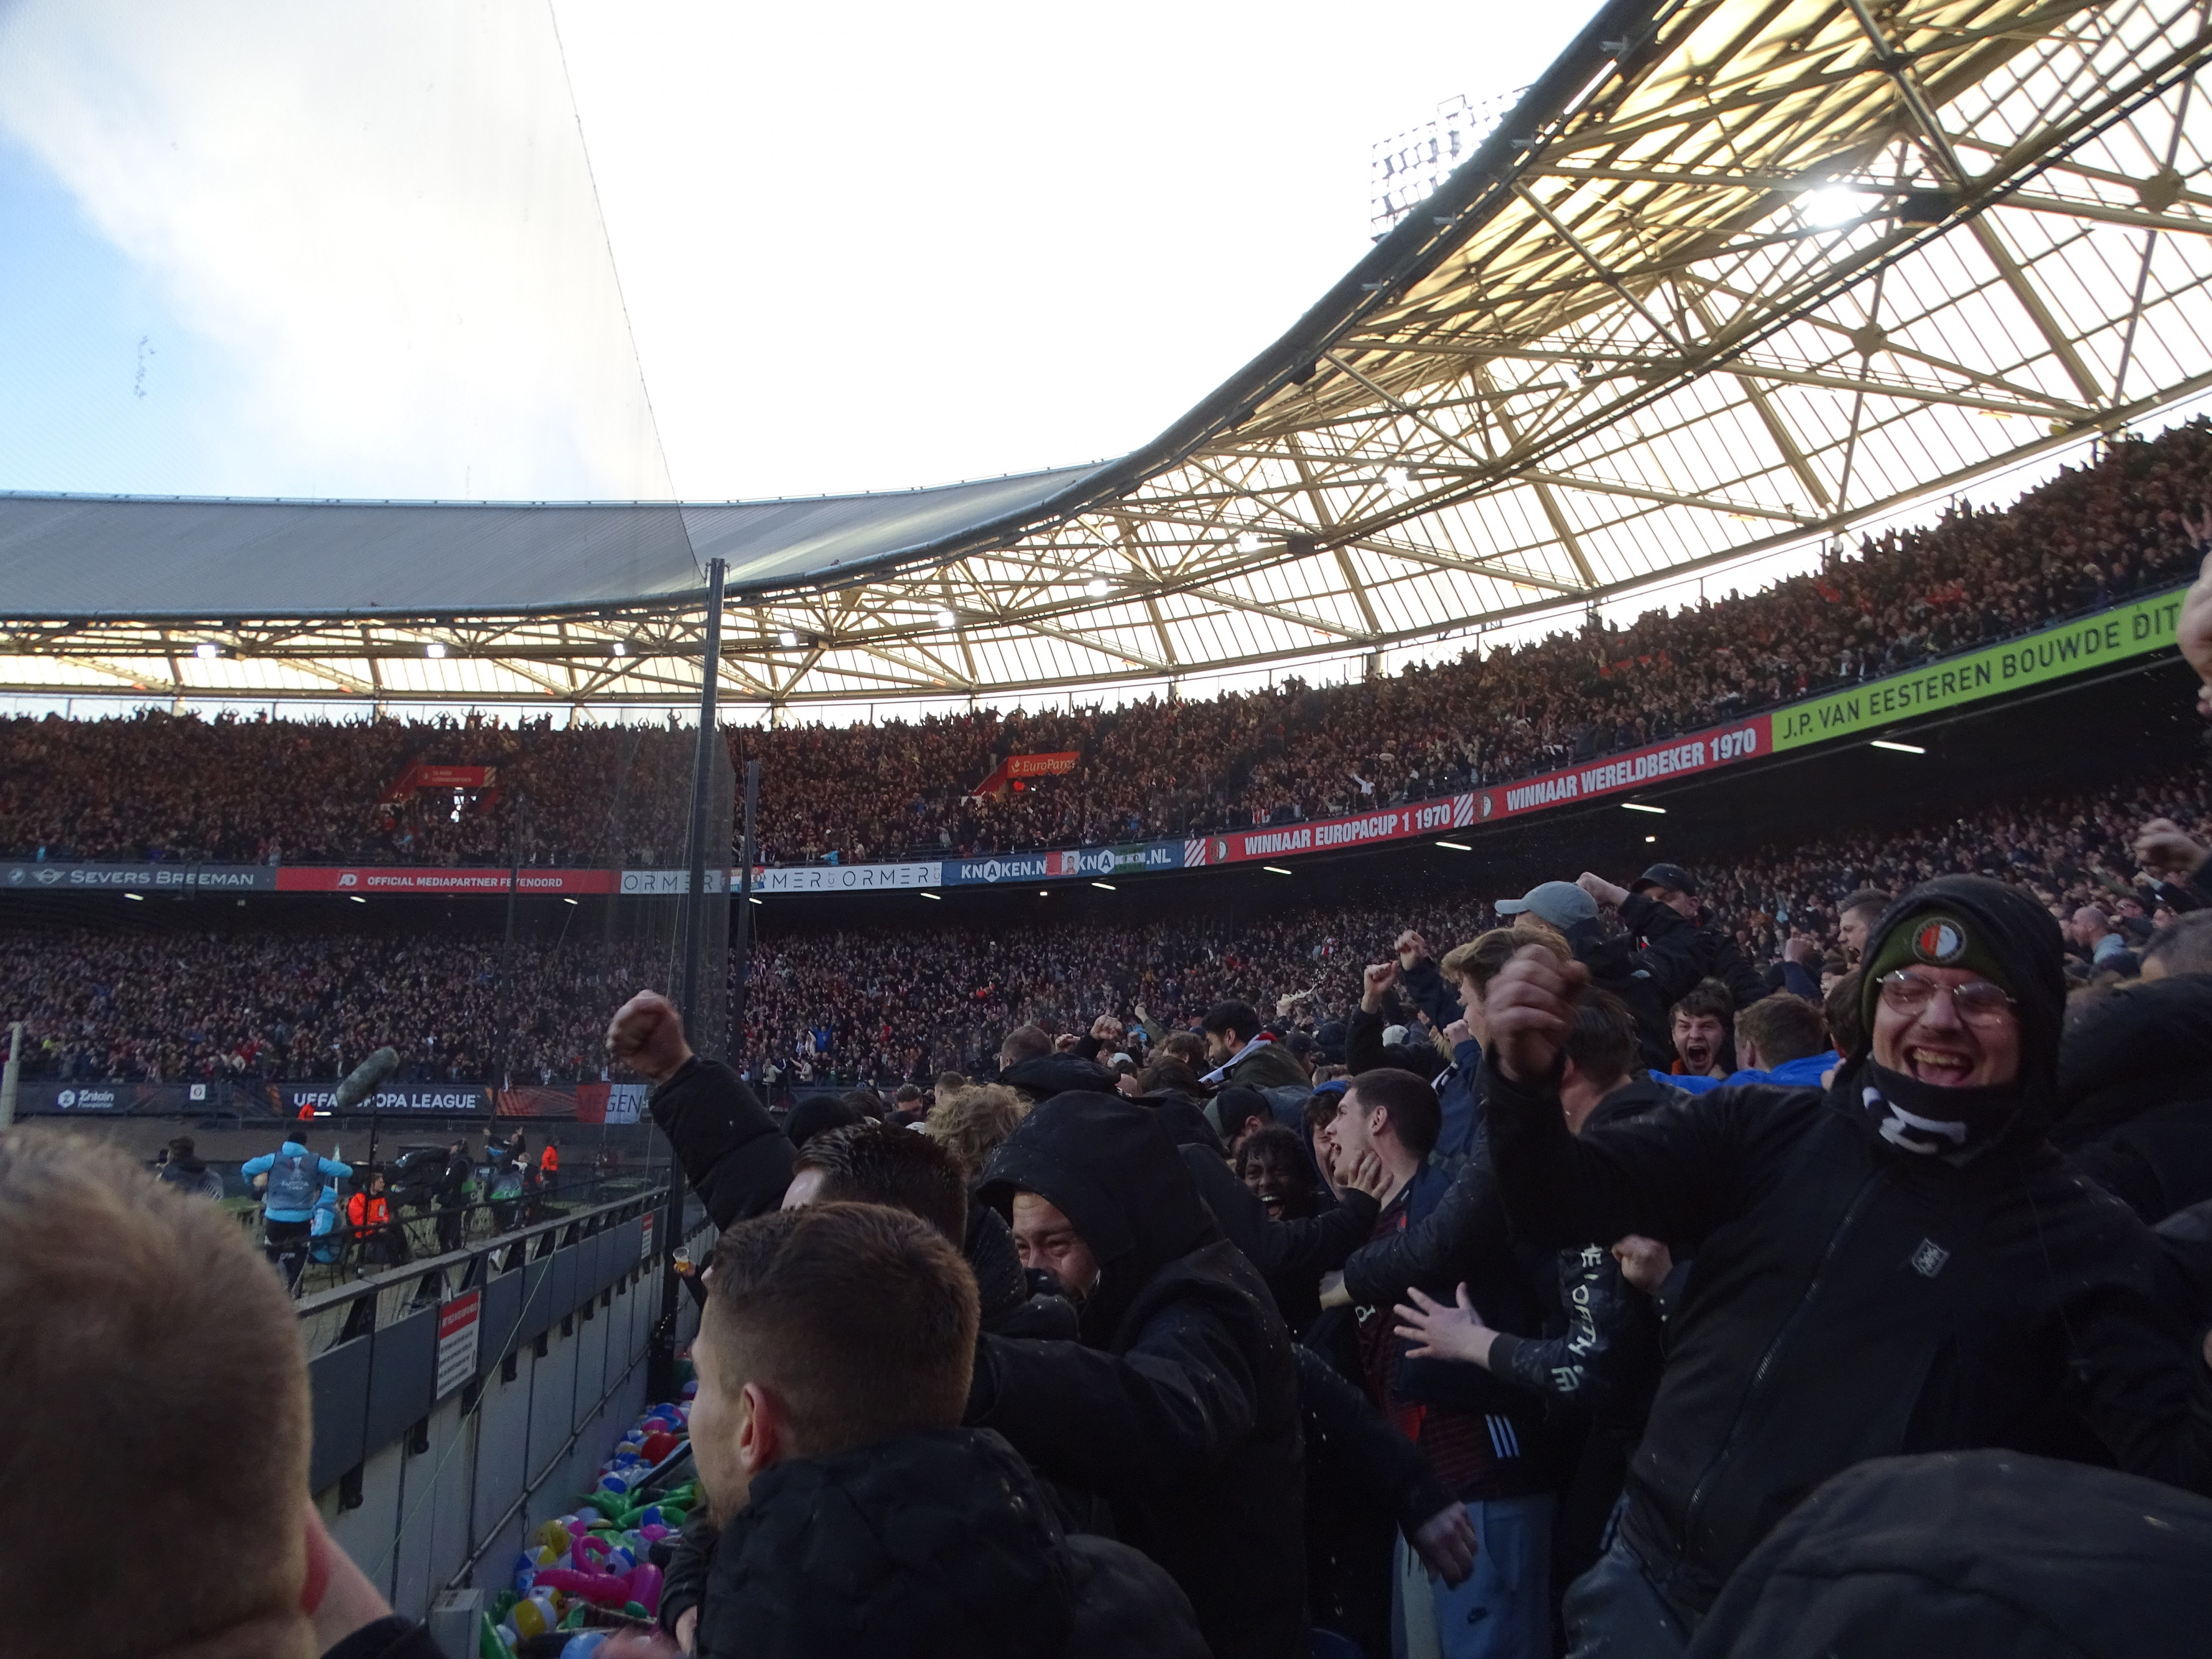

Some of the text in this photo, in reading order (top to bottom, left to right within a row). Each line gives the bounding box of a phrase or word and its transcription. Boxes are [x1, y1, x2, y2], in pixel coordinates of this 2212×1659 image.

[1783, 711, 1815, 740] J.P.
[1819, 698, 1860, 729] VAN
[1869, 660, 1992, 716] EESTEREN
[2002, 621, 2120, 678] BOUWDE
[1506, 727, 1757, 811] WINNAAR WERELDBEKER 1970
[1244, 803, 1451, 856] WINNAAR EUROPACUP 1 1970
[70, 870, 254, 886] SEVERS BREEMAN
[842, 867, 929, 887] ORMER
[933, 865, 941, 884] ICT
[961, 859, 1047, 883] KNAKEN.N
[368, 875, 414, 887] OFFICIAL
[416, 876, 498, 888] MEDIAPARTNER
[294, 1092, 339, 1108] UEFA
[412, 1093, 476, 1109] LEAGUE
